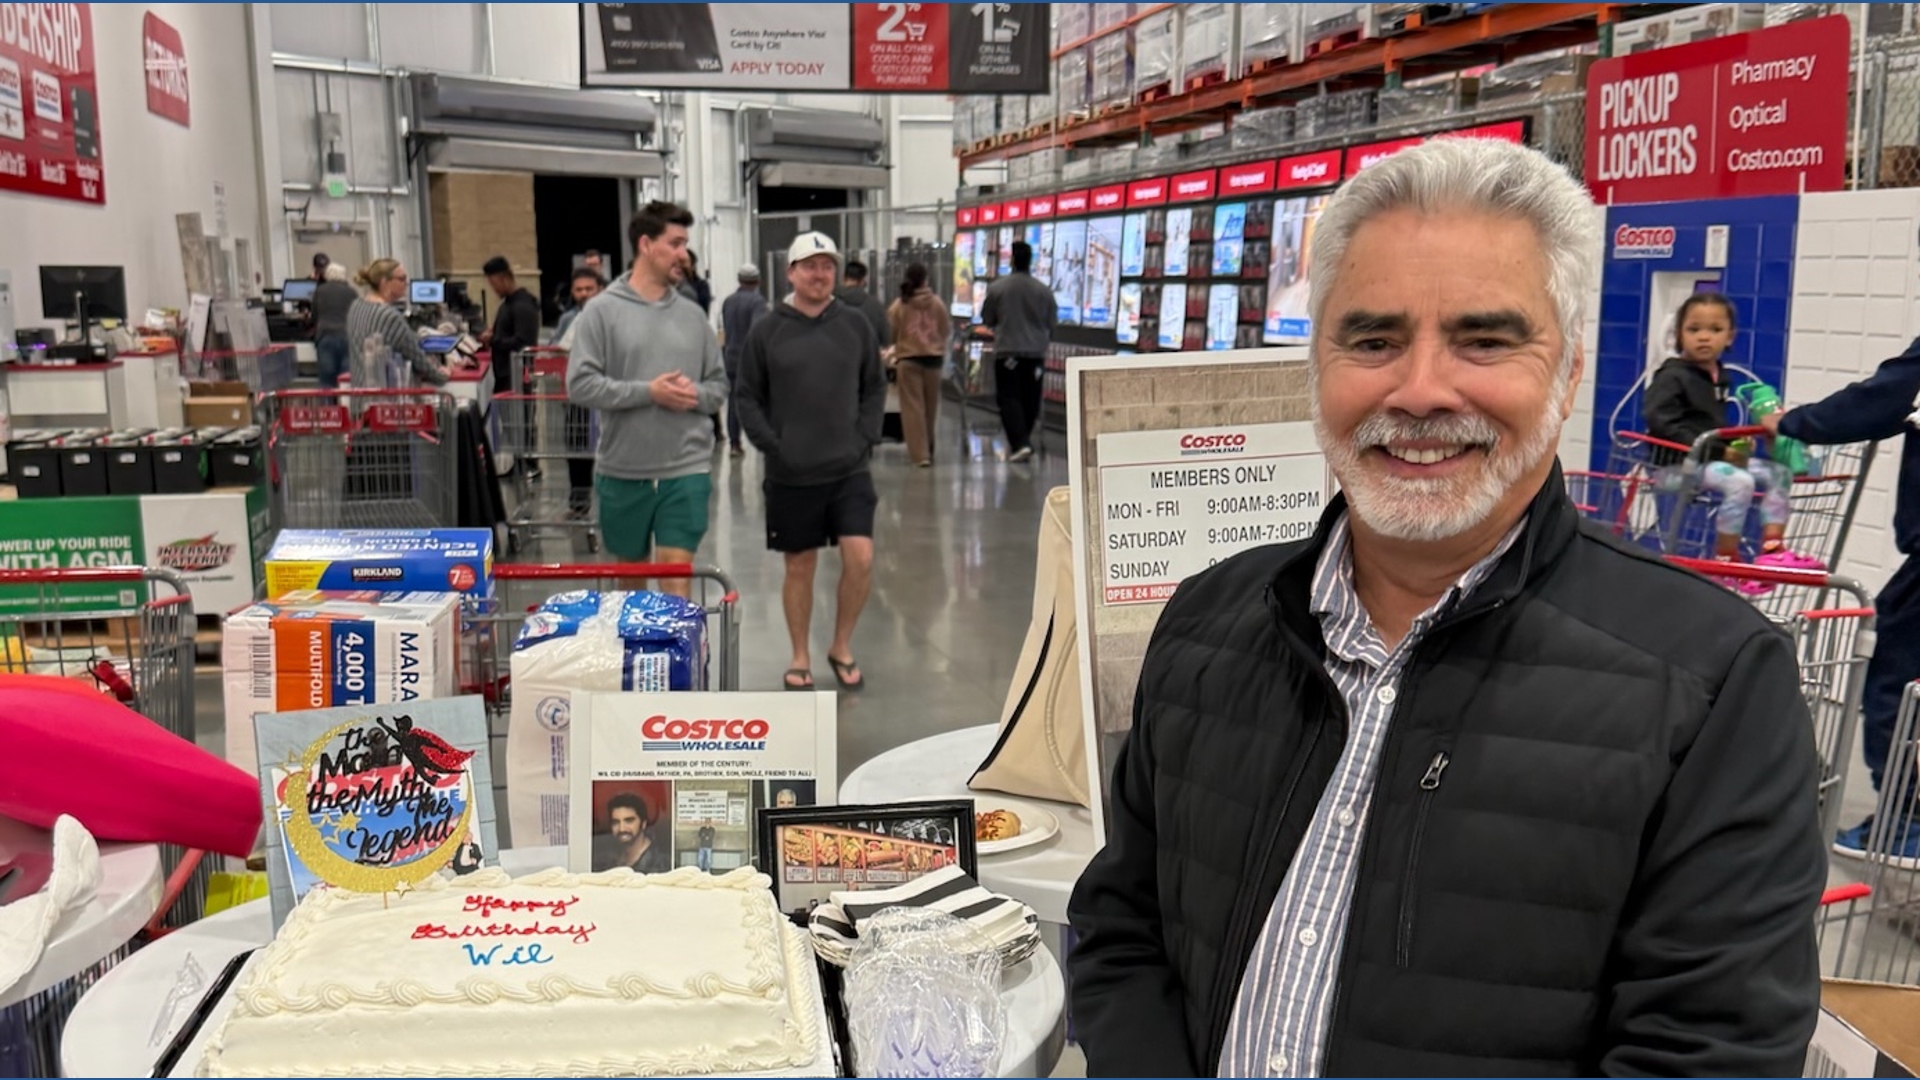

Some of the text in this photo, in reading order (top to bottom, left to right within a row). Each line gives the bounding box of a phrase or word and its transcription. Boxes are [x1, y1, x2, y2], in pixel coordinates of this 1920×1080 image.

[730, 29, 760, 38] Costco
[762, 29, 805, 40] Anywhere
[731, 41, 751, 49] Card
[753, 41, 765, 51] by
[870, 44, 934, 53] ON ALL OTHER
[696, 58, 722, 70] VISA
[730, 61, 826, 75] APPLY TODAY
[872, 54, 910, 63] COSTCO
[970, 65, 1021, 75] PURCHASES
[1731, 55, 1816, 85] Pharmacy
[1600, 72, 1679, 129] PICKUP
[1729, 99, 1787, 132] Optical
[1598, 125, 1697, 181] LOCKERS
[1728, 145, 1823, 172] Costco.com
[1616, 225, 1675, 246] COSTCO
[1180, 434, 1246, 449] COSTCO
[1202, 446, 1244, 454] WHOLESALE
[1151, 465, 1277, 488] MEMBERS ONLY
[1108, 503, 1142, 520] MON
[1157, 501, 1180, 517] FRI
[1207, 491, 1320, 514] 9:00AM-8:30PM
[36, 538, 55, 551] UP
[58, 537, 97, 551] YOUR
[99, 535, 132, 549] RIDE
[1109, 530, 1187, 550] SATURDAY
[69, 550, 134, 567] AGM
[157, 544, 236, 557] INTERSTATE
[160, 556, 230, 567] BATTERIES
[1110, 561, 1170, 579] SUNDAY
[353, 567, 403, 577] KIRKLAND
[450, 569, 461, 586] 7
[1107, 589, 1133, 601] OPEN
[1135, 588, 1148, 599] 24
[309, 631, 324, 707] MULTIFOLD
[342, 632, 365, 691] 4,000
[400, 632, 419, 702] MARA
[642, 715, 769, 740] COSTCO
[681, 741, 766, 751] WHOLESALE
[307, 780, 353, 814] the
[345, 806, 456, 866] Legend
[462, 895, 580, 917] Happy
[411, 921, 597, 943] Birthday
[462, 943, 554, 965] Wil
